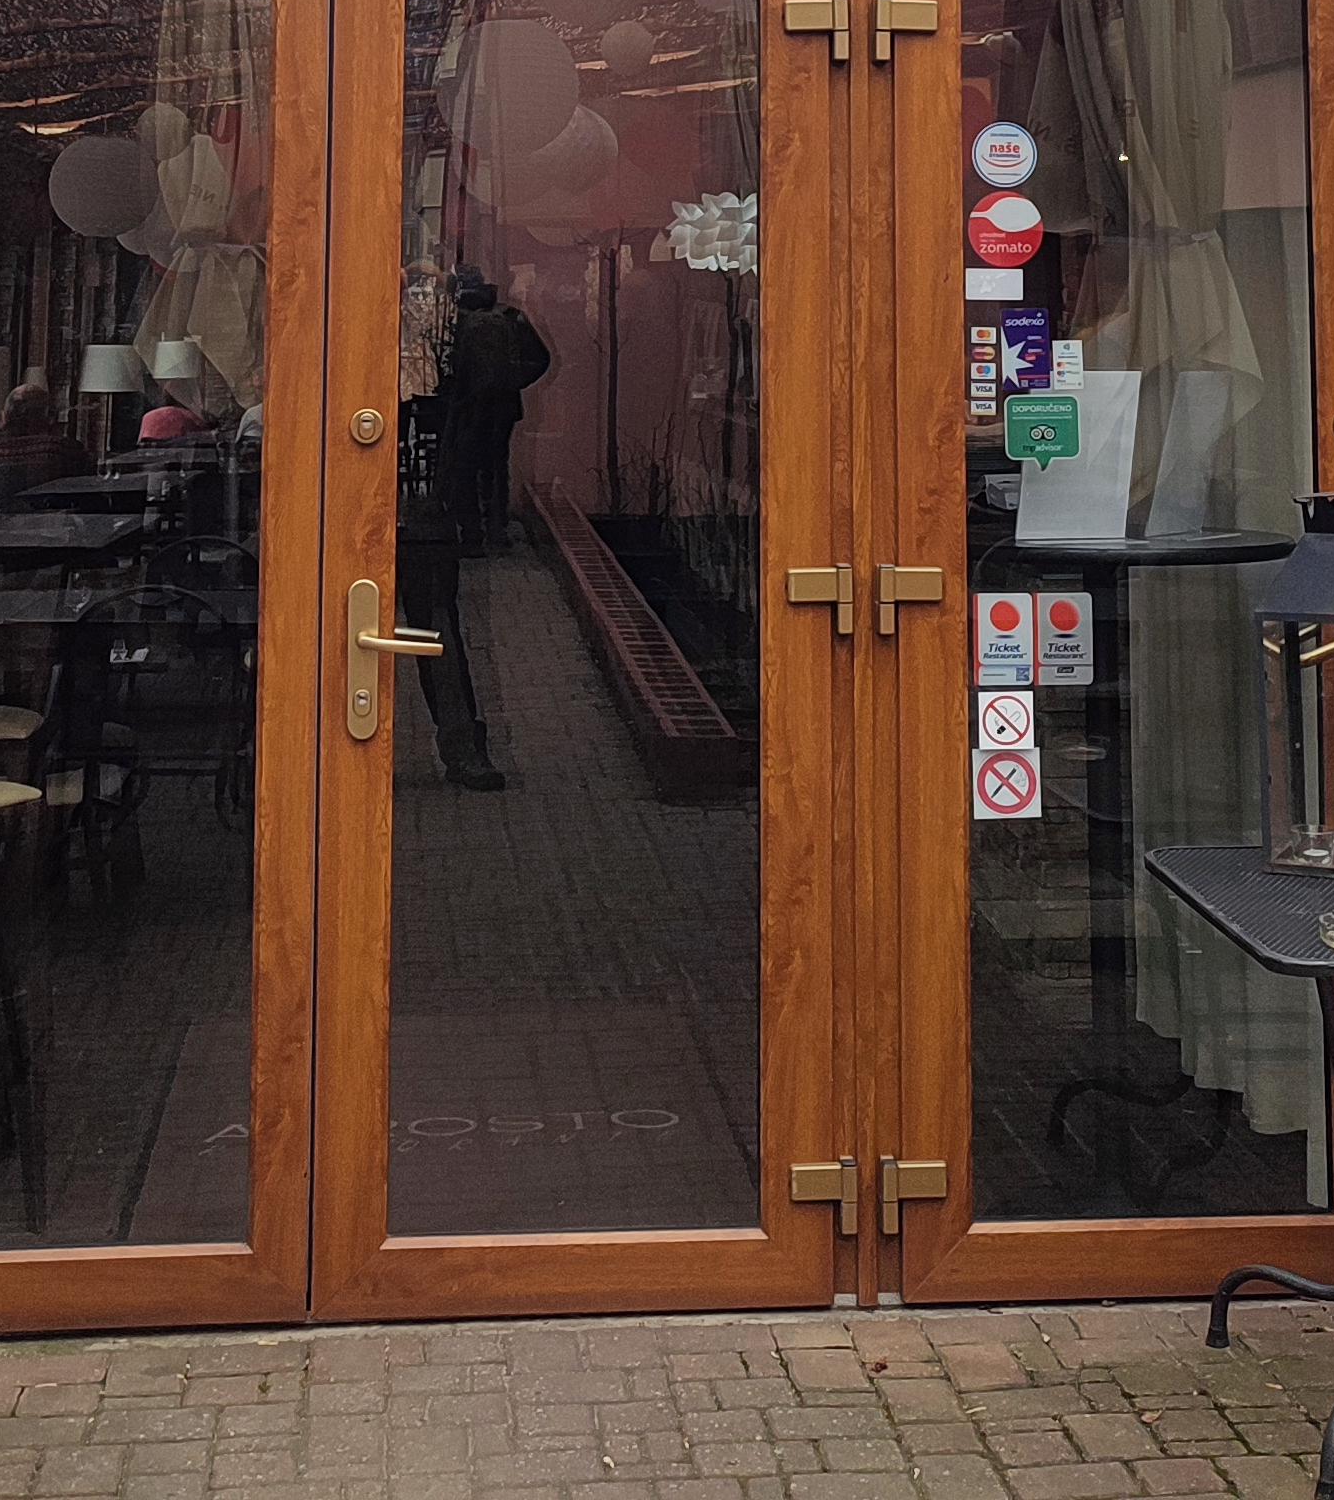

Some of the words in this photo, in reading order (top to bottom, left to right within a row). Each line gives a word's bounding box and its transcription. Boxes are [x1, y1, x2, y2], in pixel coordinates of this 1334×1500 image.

[990, 142, 1020, 153] naše
[979, 242, 1032, 254] zomato
[1005, 312, 1045, 326] sodexo
[975, 385, 993, 393] VISA
[1012, 403, 1073, 413] DOPORUČENO
[988, 643, 1021, 653] Ticket
[1047, 642, 1081, 653] Ticket
